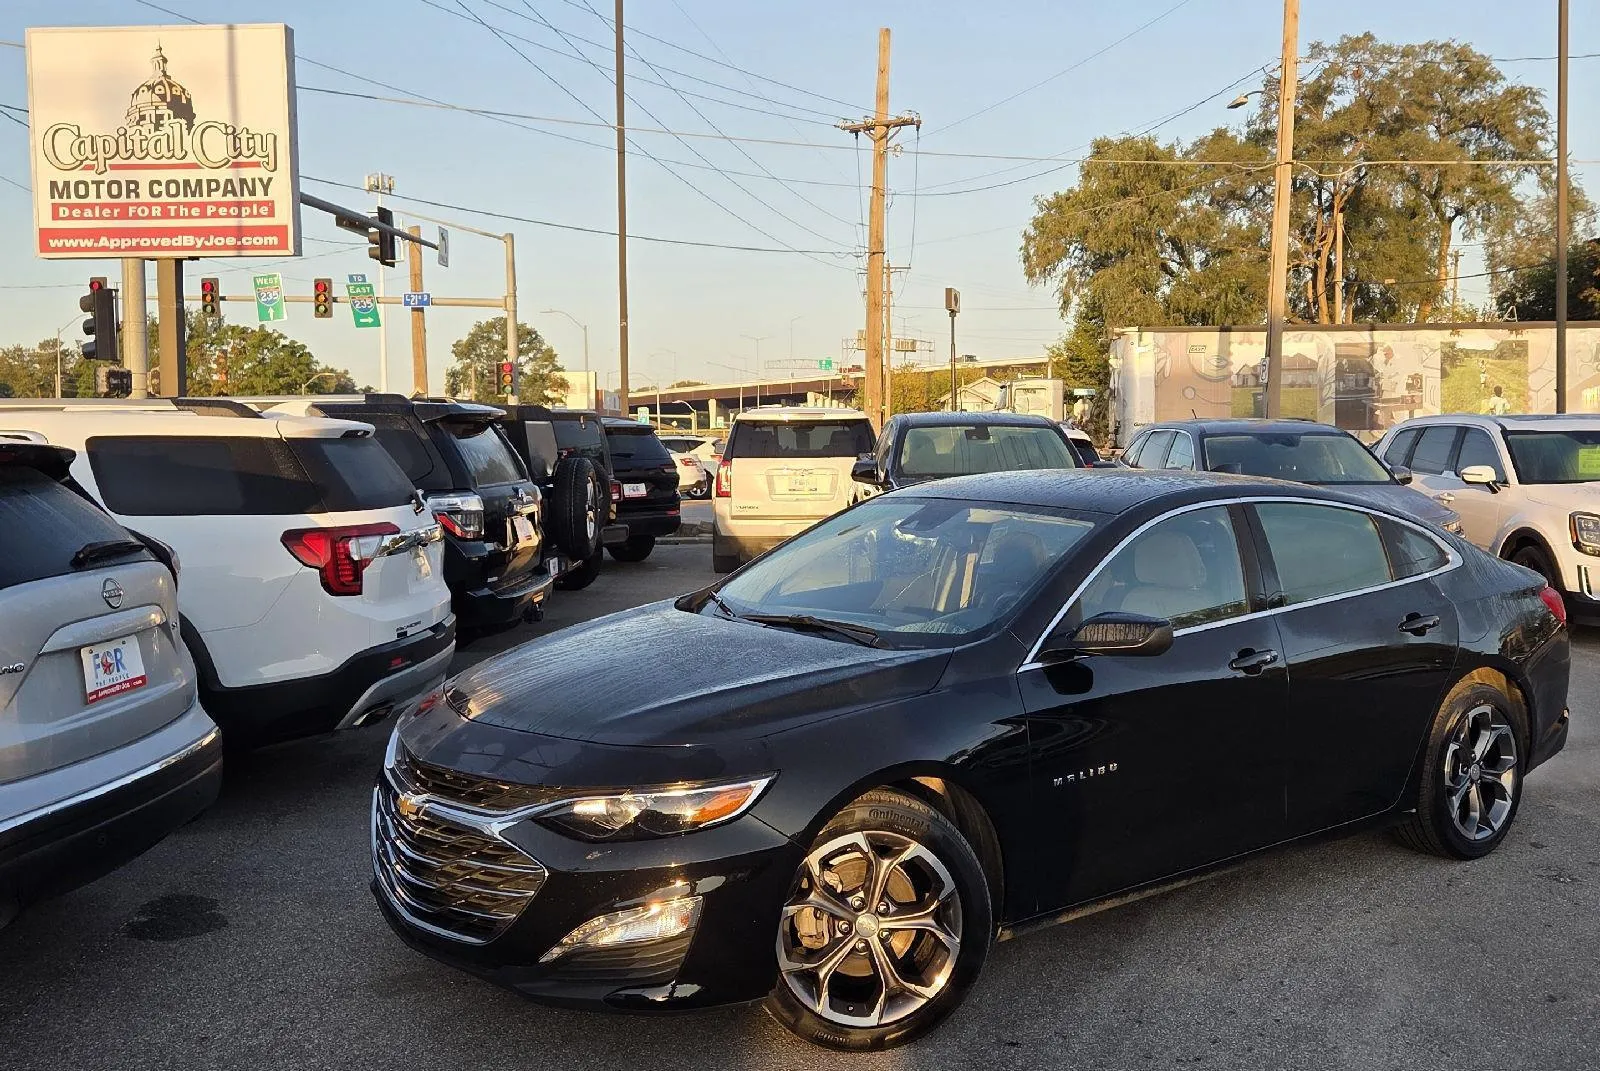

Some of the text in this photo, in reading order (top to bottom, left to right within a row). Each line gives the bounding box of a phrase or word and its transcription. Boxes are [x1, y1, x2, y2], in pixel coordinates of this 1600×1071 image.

[42, 121, 278, 175] Capital City
[49, 177, 274, 199] MOTOR COMPANY
[58, 203, 270, 218] Dealer FOR The People
[49, 235, 278, 249] www.ApprovedByJoe.com
[256, 276, 279, 286] WEST
[260, 291, 279, 302] 235
[349, 285, 371, 294] EAST
[354, 299, 374, 309] 235
[92, 647, 128, 679] FOR
[1053, 762, 1118, 787] MALIBU
[868, 808, 925, 828] Continental
